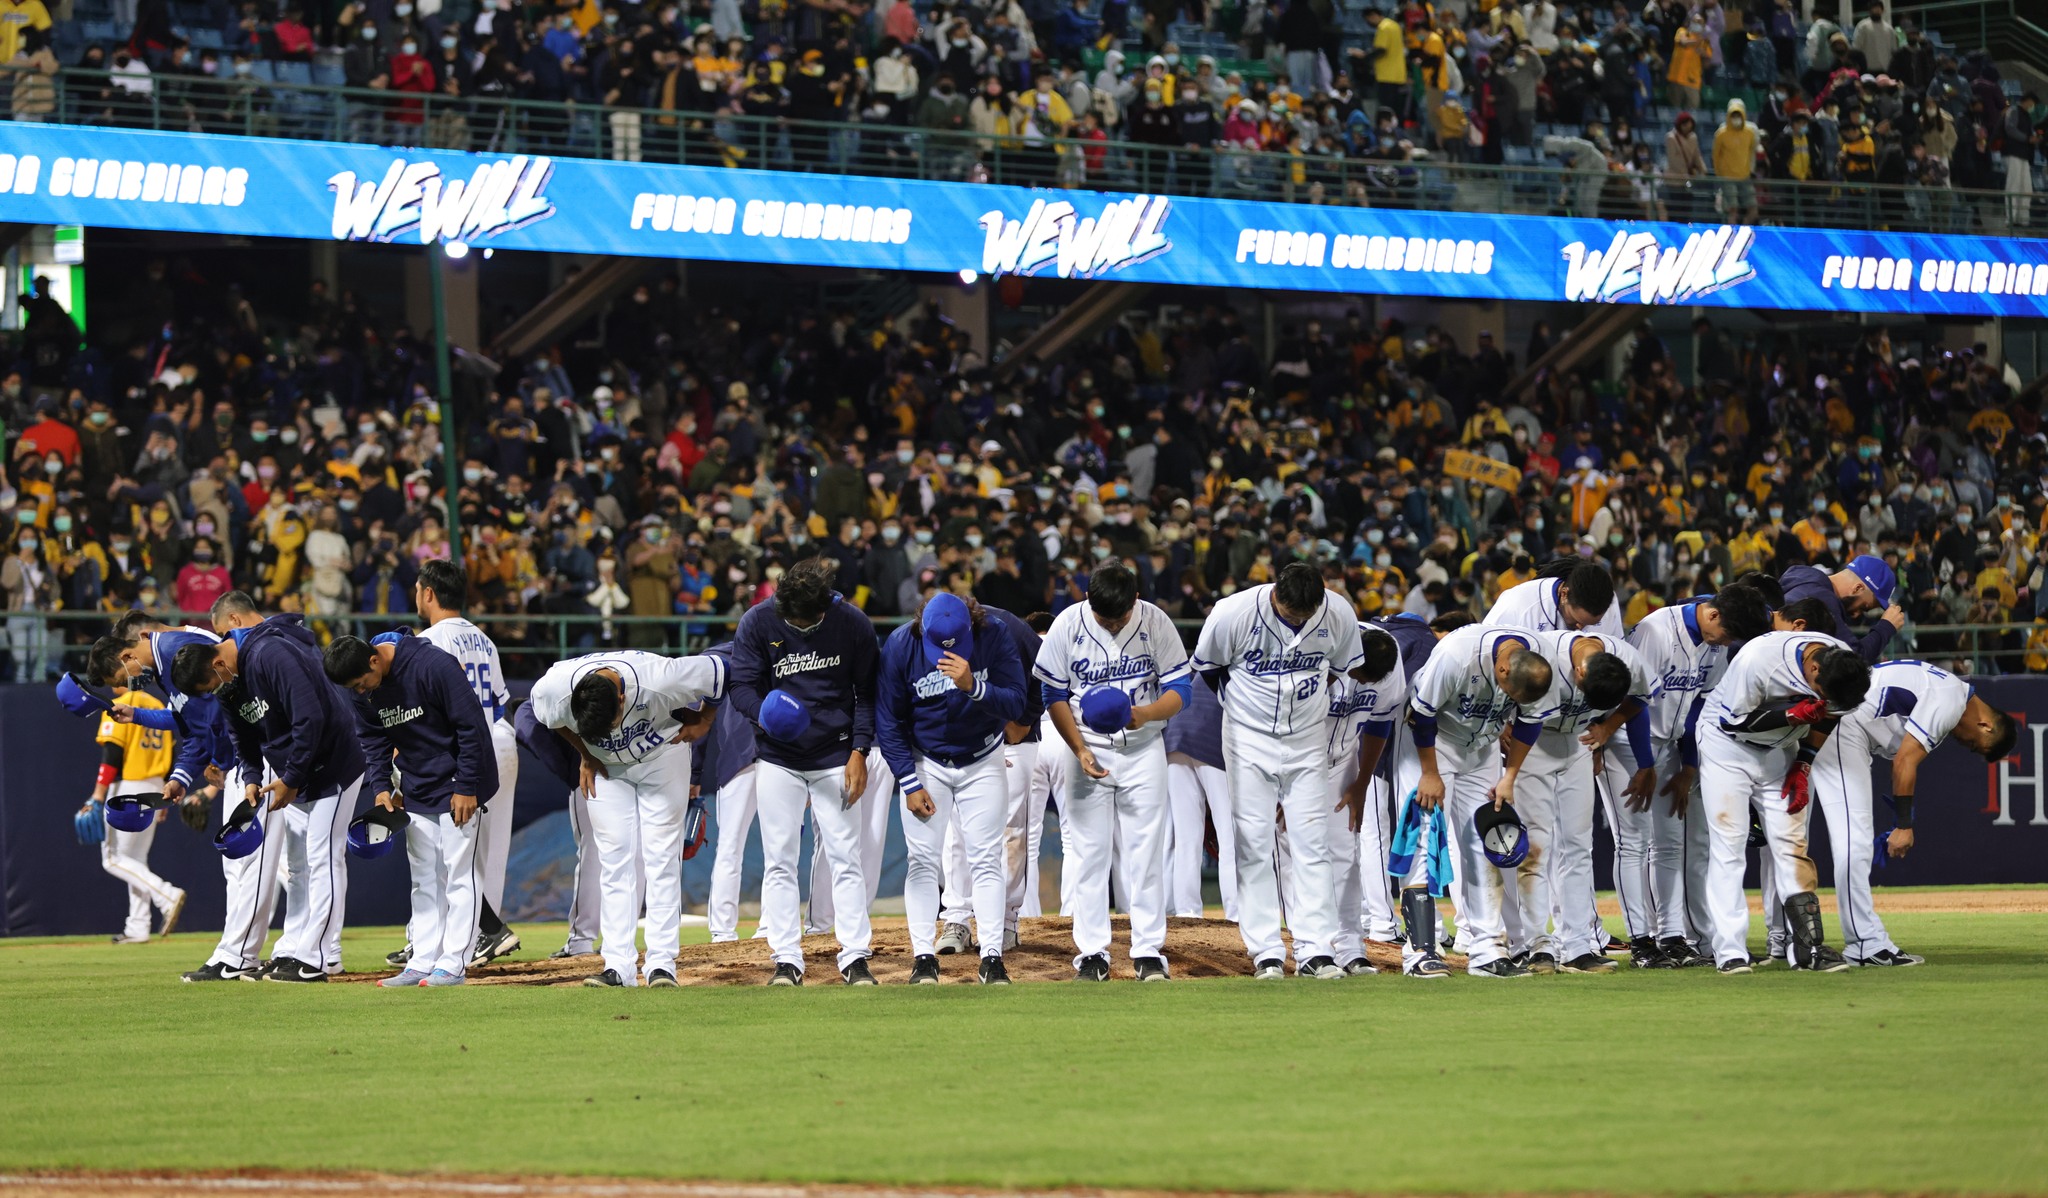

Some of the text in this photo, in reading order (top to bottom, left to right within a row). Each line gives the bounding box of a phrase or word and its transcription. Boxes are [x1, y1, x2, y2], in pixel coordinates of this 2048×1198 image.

[49, 157, 249, 207] GUARDIANS
[326, 155, 556, 245] WE WILL
[630, 193, 912, 244] FUBON GUARDIANS
[978, 194, 1173, 279] WE WILL
[1235, 228, 1494, 275] FUBON GUARDIANS
[1560, 225, 1756, 305] WE WILL
[1821, 255, 2048, 297] FUBON GUARDIAN
[772, 650, 841, 679] Guardians
[926, 669, 953, 685] Fub
[1242, 648, 1325, 677] Guardian
[382, 705, 424, 728] uardians
